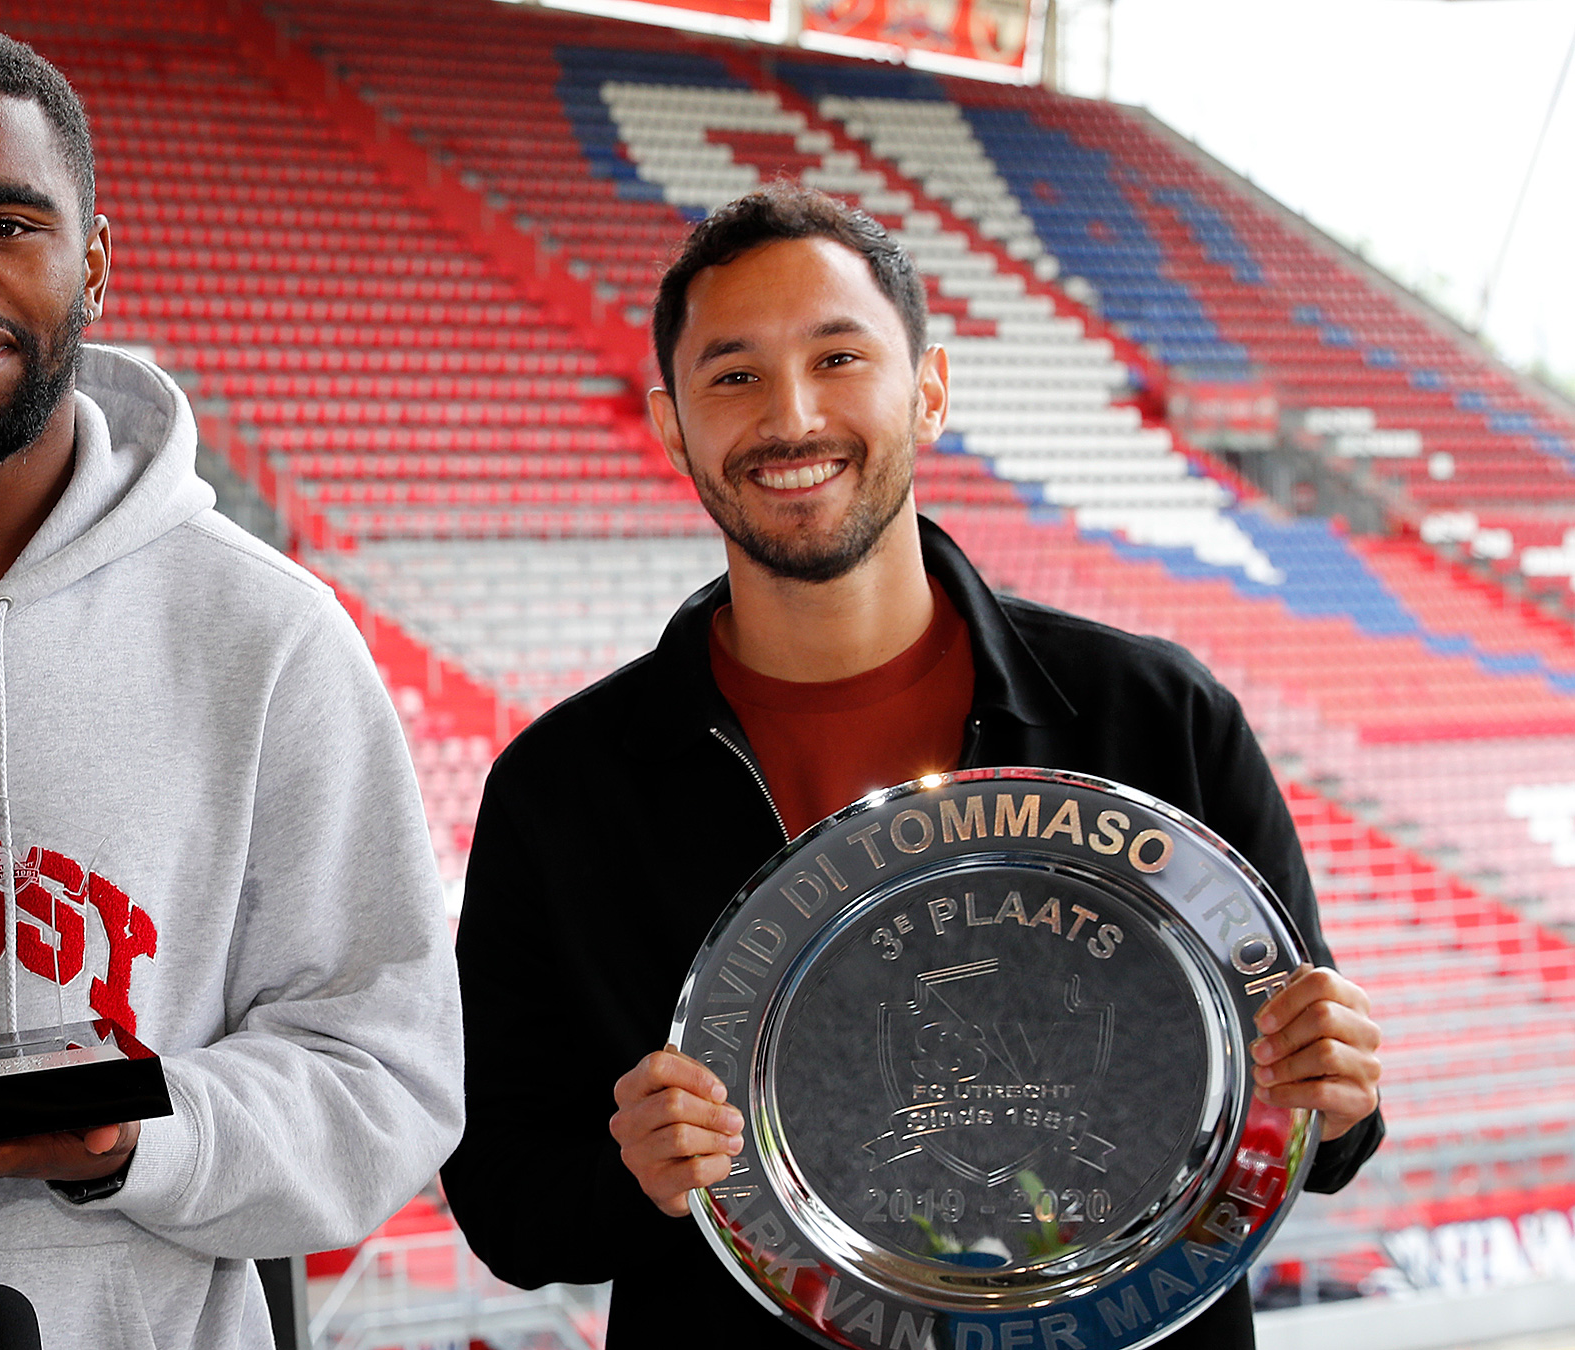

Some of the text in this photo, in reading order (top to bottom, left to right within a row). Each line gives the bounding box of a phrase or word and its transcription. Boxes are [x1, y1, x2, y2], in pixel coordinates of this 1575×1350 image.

[779, 853, 849, 919] DI
[846, 793, 1175, 874] TOMMASO
[926, 890, 1124, 959] PLAATS
[912, 1083, 1075, 1100] FC UTRECHT
[1005, 1106, 1075, 1134] 1981
[862, 1187, 966, 1224] 2019
[1007, 1187, 1112, 1224] 2020
[711, 1156, 821, 1290] ARK
[821, 1275, 937, 1350] VAN
[1095, 1147, 1290, 1338] MAAREL
